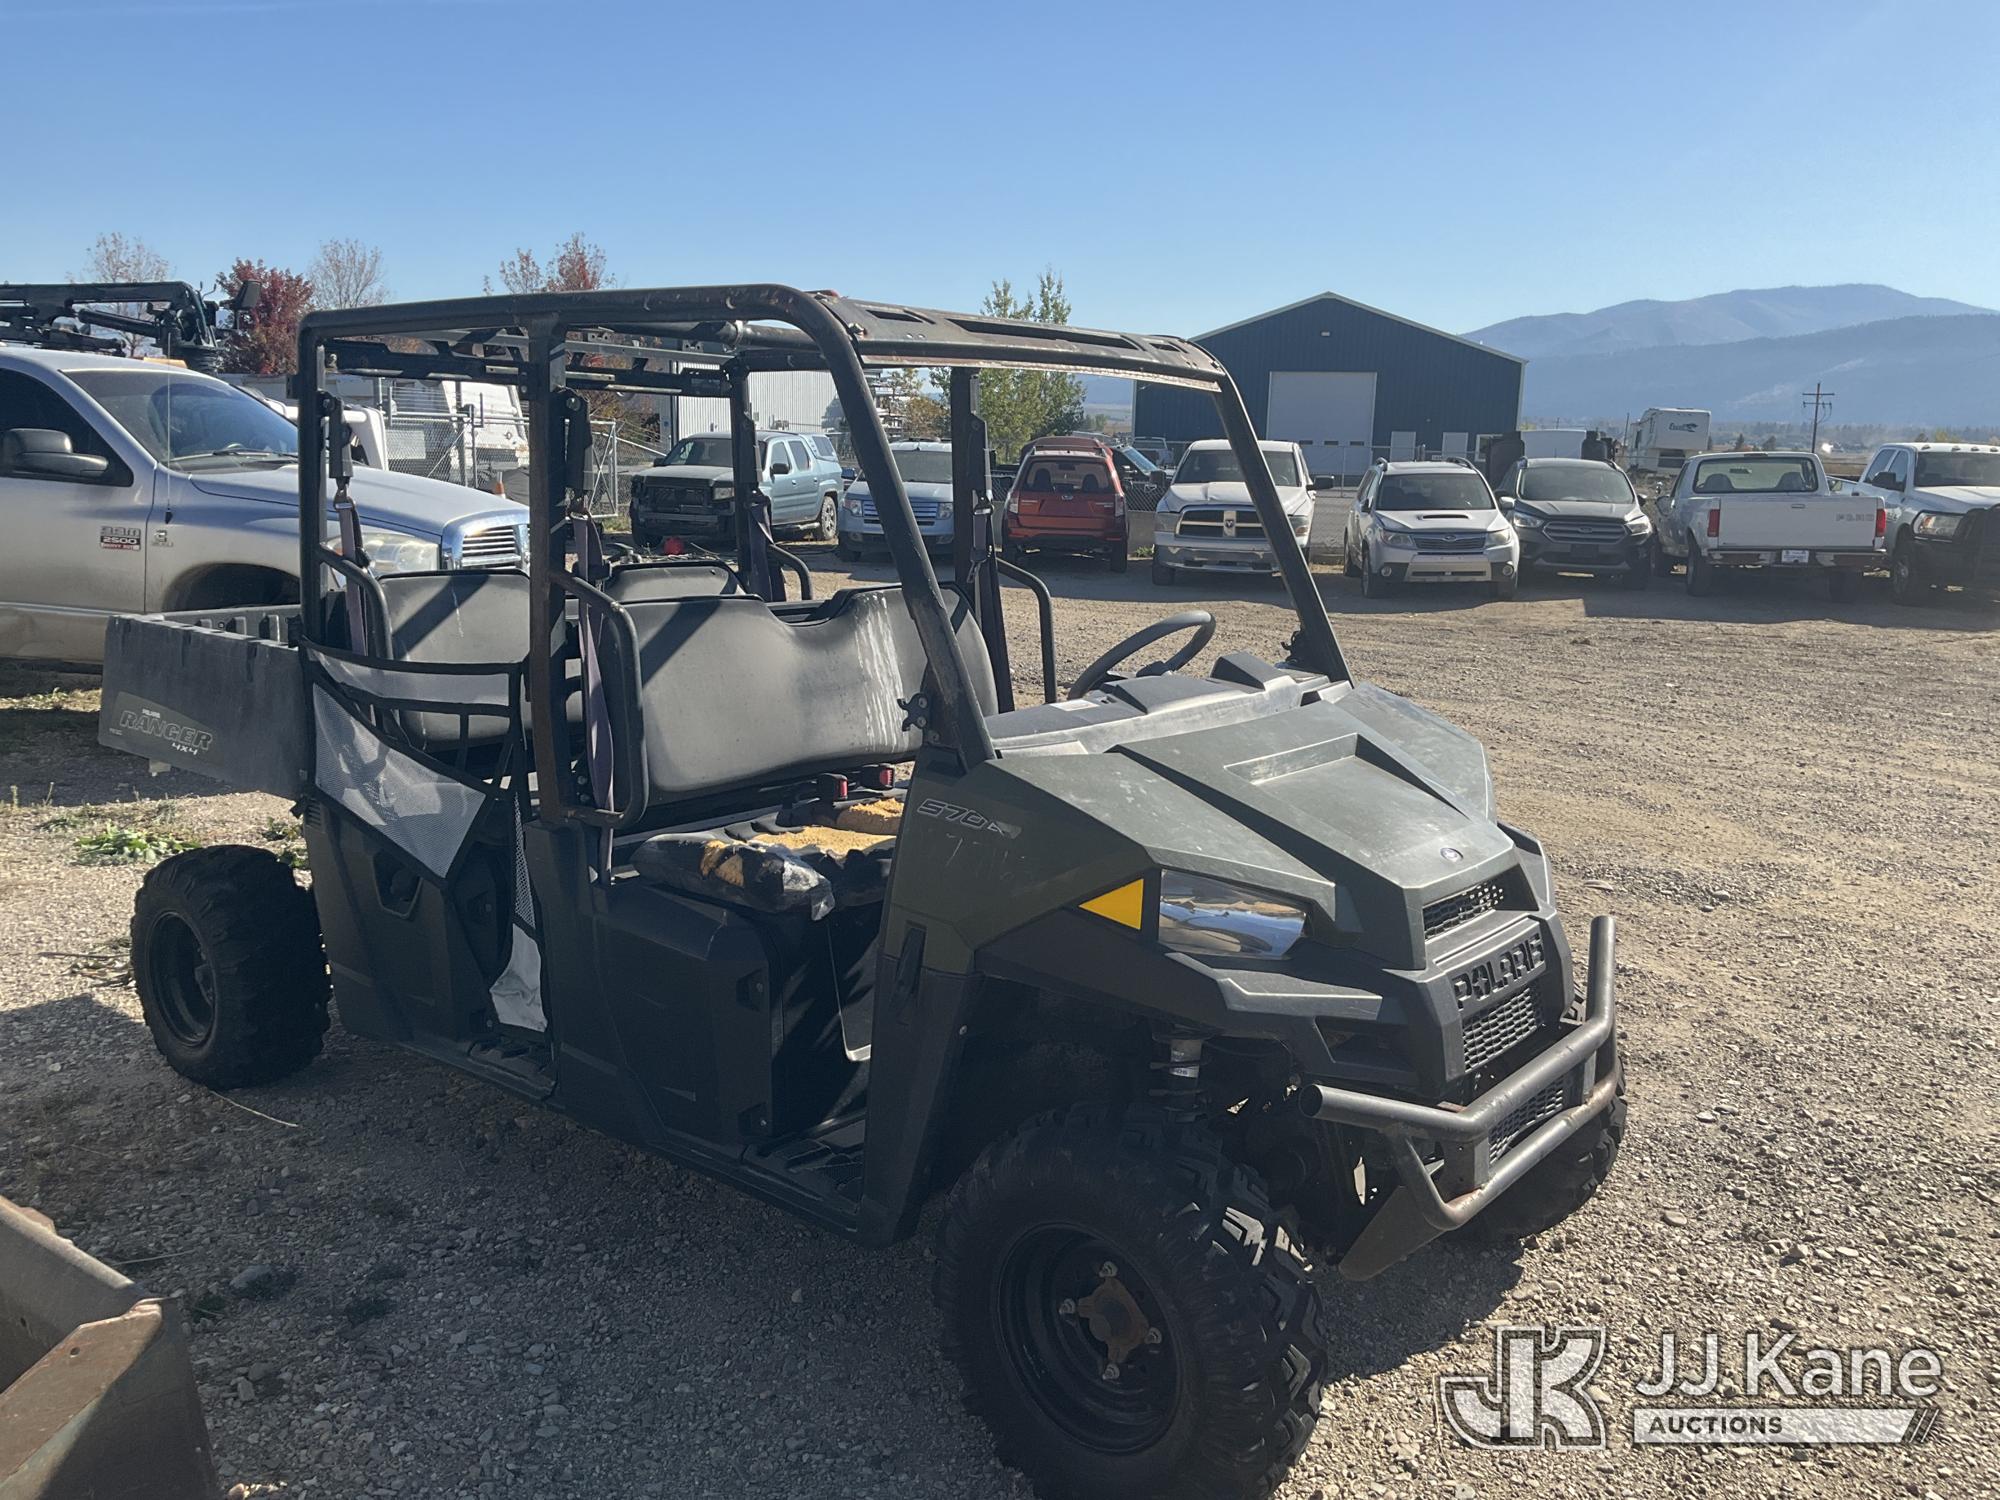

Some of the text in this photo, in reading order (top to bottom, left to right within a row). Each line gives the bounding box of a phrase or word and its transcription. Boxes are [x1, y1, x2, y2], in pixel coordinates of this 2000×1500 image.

[102, 536, 138, 545] 2500
[120, 710, 213, 751] RANGER
[917, 798, 988, 829] 570
[1451, 932, 1545, 1011] POLARIS
